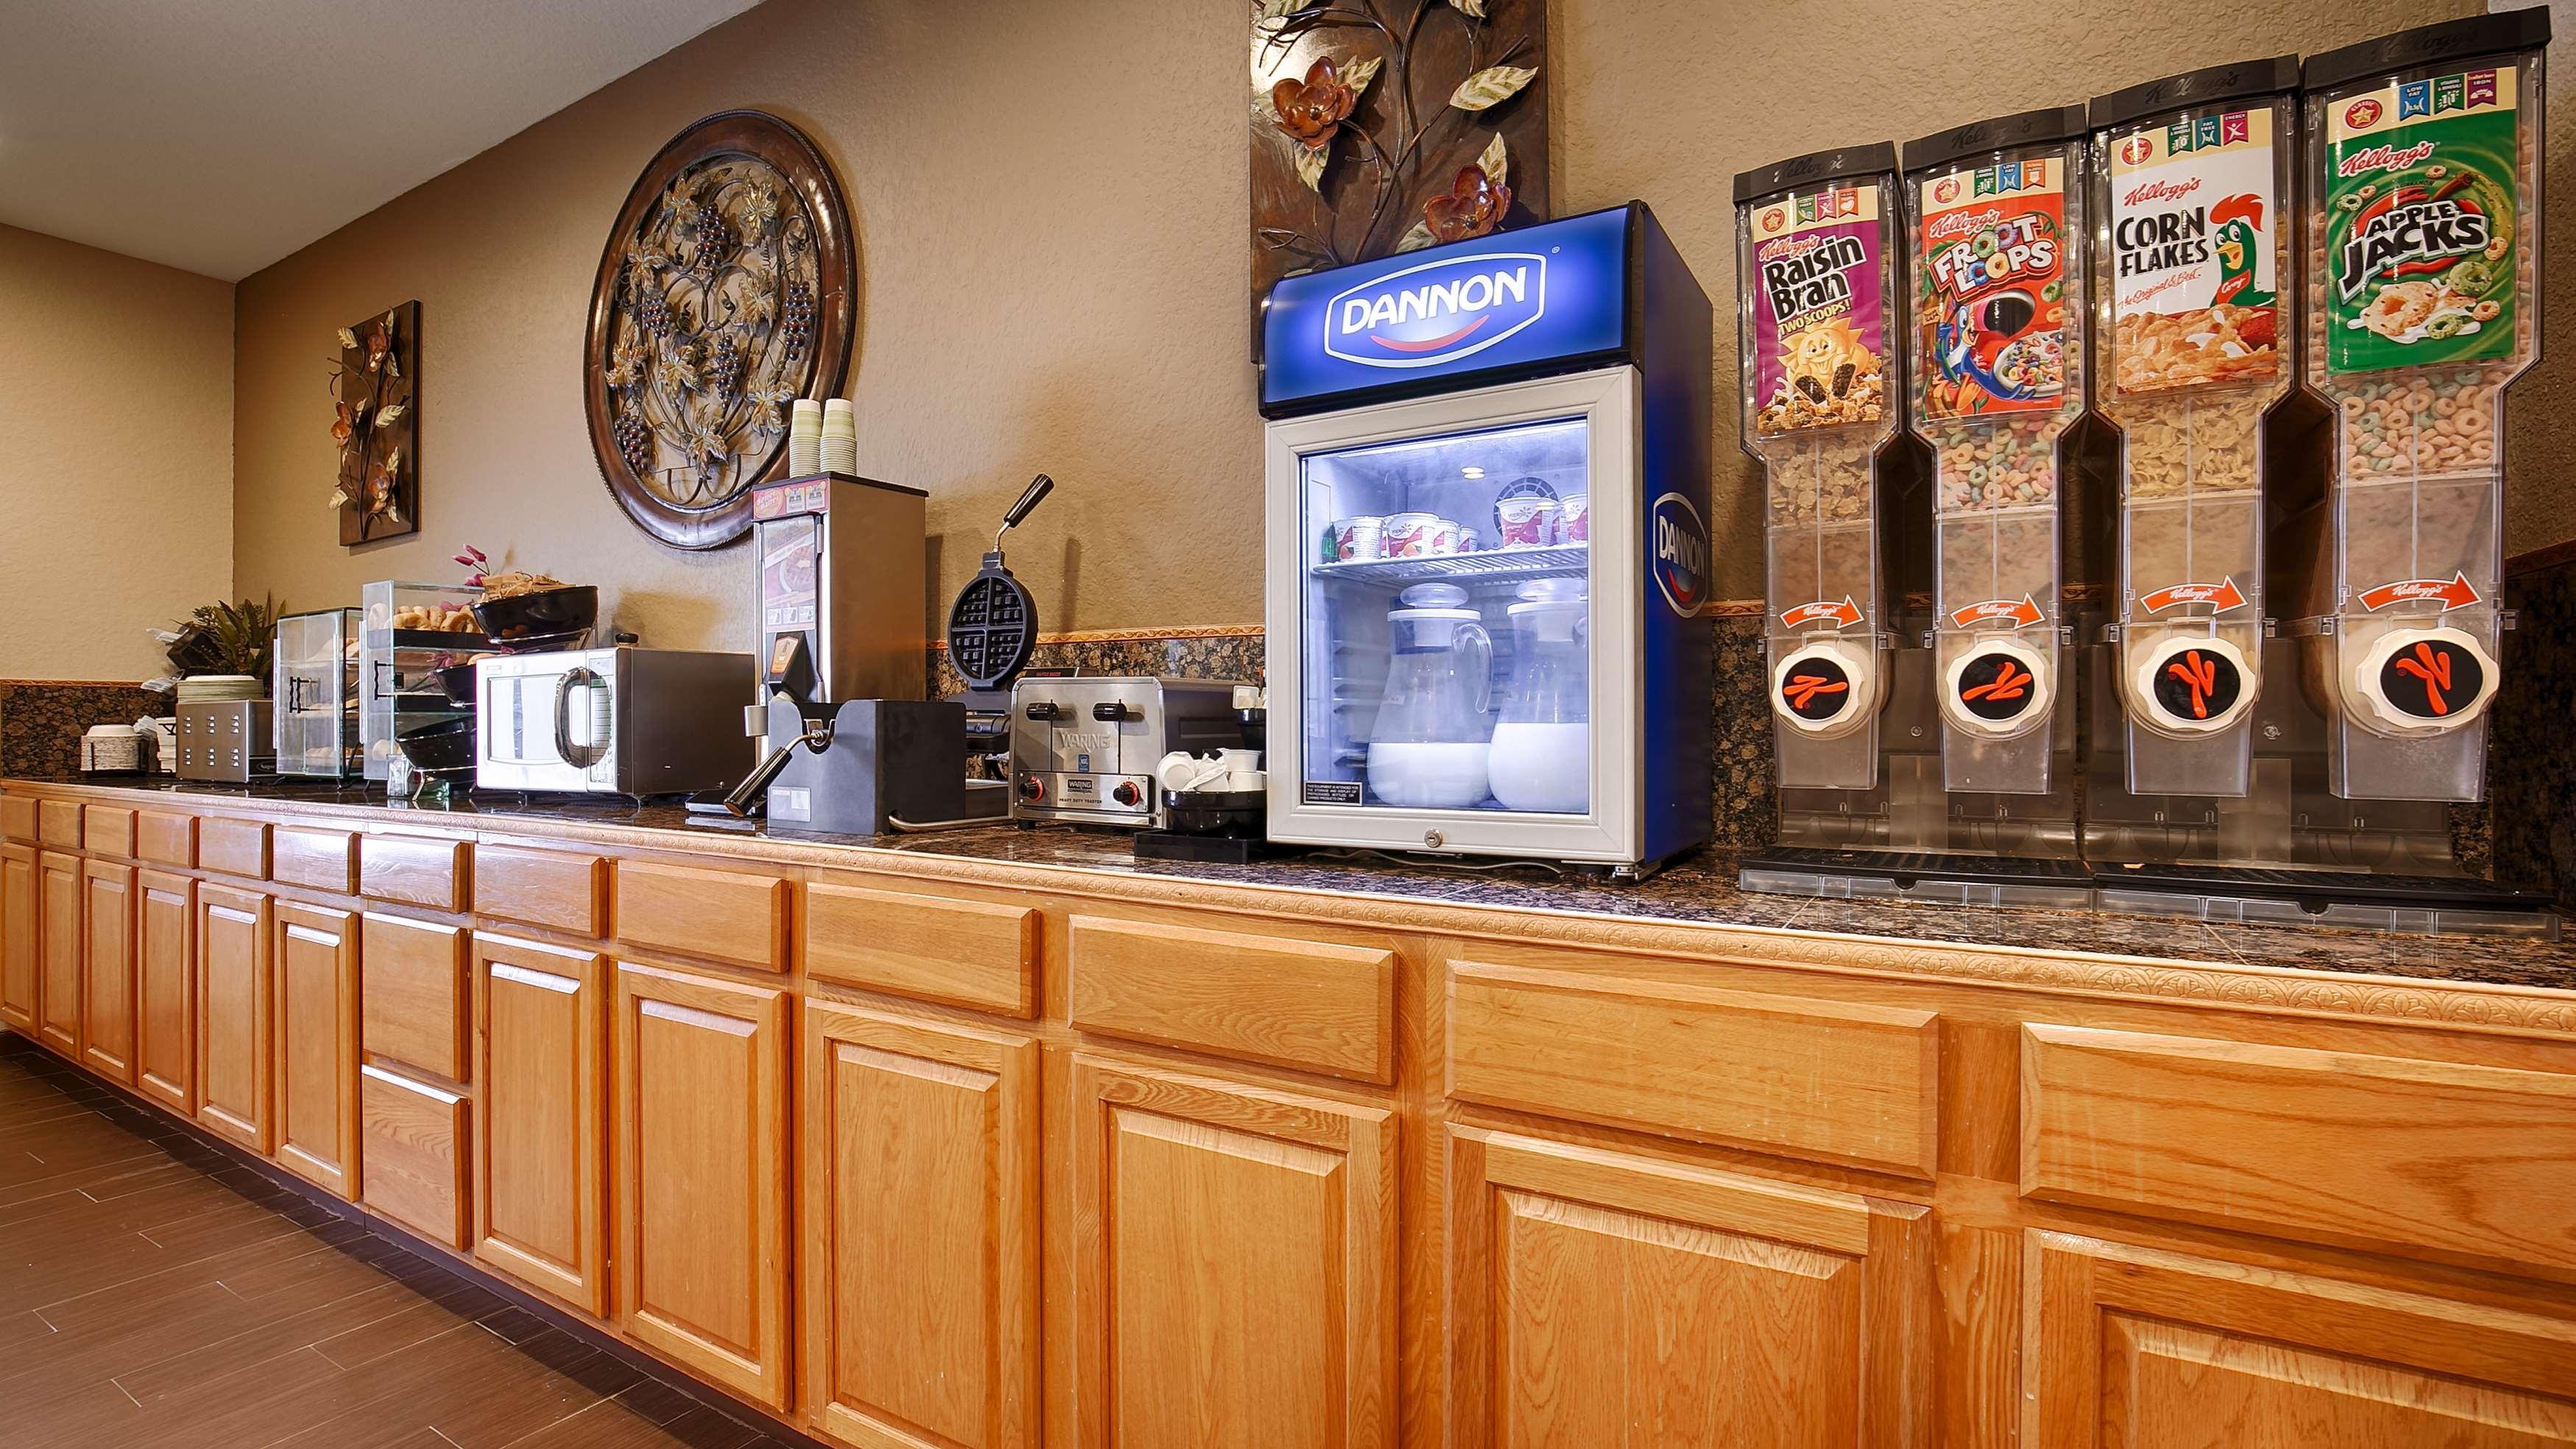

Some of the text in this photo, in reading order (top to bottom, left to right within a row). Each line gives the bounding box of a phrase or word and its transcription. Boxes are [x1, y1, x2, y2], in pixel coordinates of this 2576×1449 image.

[2338, 140, 2435, 177] Kellogg's
[2124, 177, 2201, 206] Kellogg's
[1929, 209, 2000, 238] Kellogg's
[2117, 207, 2205, 252] CORN
[2365, 201, 2456, 240] APPLE
[1759, 234, 1820, 262] Kellogg's
[1763, 235, 1865, 293] Raisin
[1933, 216, 2038, 283] FROOT
[1954, 241, 2054, 293] LOOPS
[2120, 239, 2209, 277] FLAKES
[2341, 215, 2485, 296] JACKS
[1342, 266, 1527, 335] DANNON
[1770, 271, 1850, 322] Bran
[2133, 278, 2169, 304] Original
[2176, 266, 2201, 286] Best
[1779, 298, 1851, 336] TWO SCOOPS!
[1659, 515, 1705, 578] DANNON
[2170, 587, 2214, 600] Kellogg's
[2392, 583, 2443, 598] Kellogg's
[1802, 605, 1838, 617] Kellogg's
[1975, 603, 2015, 617] Kellogg's
[1059, 731, 1111, 753] WARING
[1069, 780, 1091, 788] WARING
